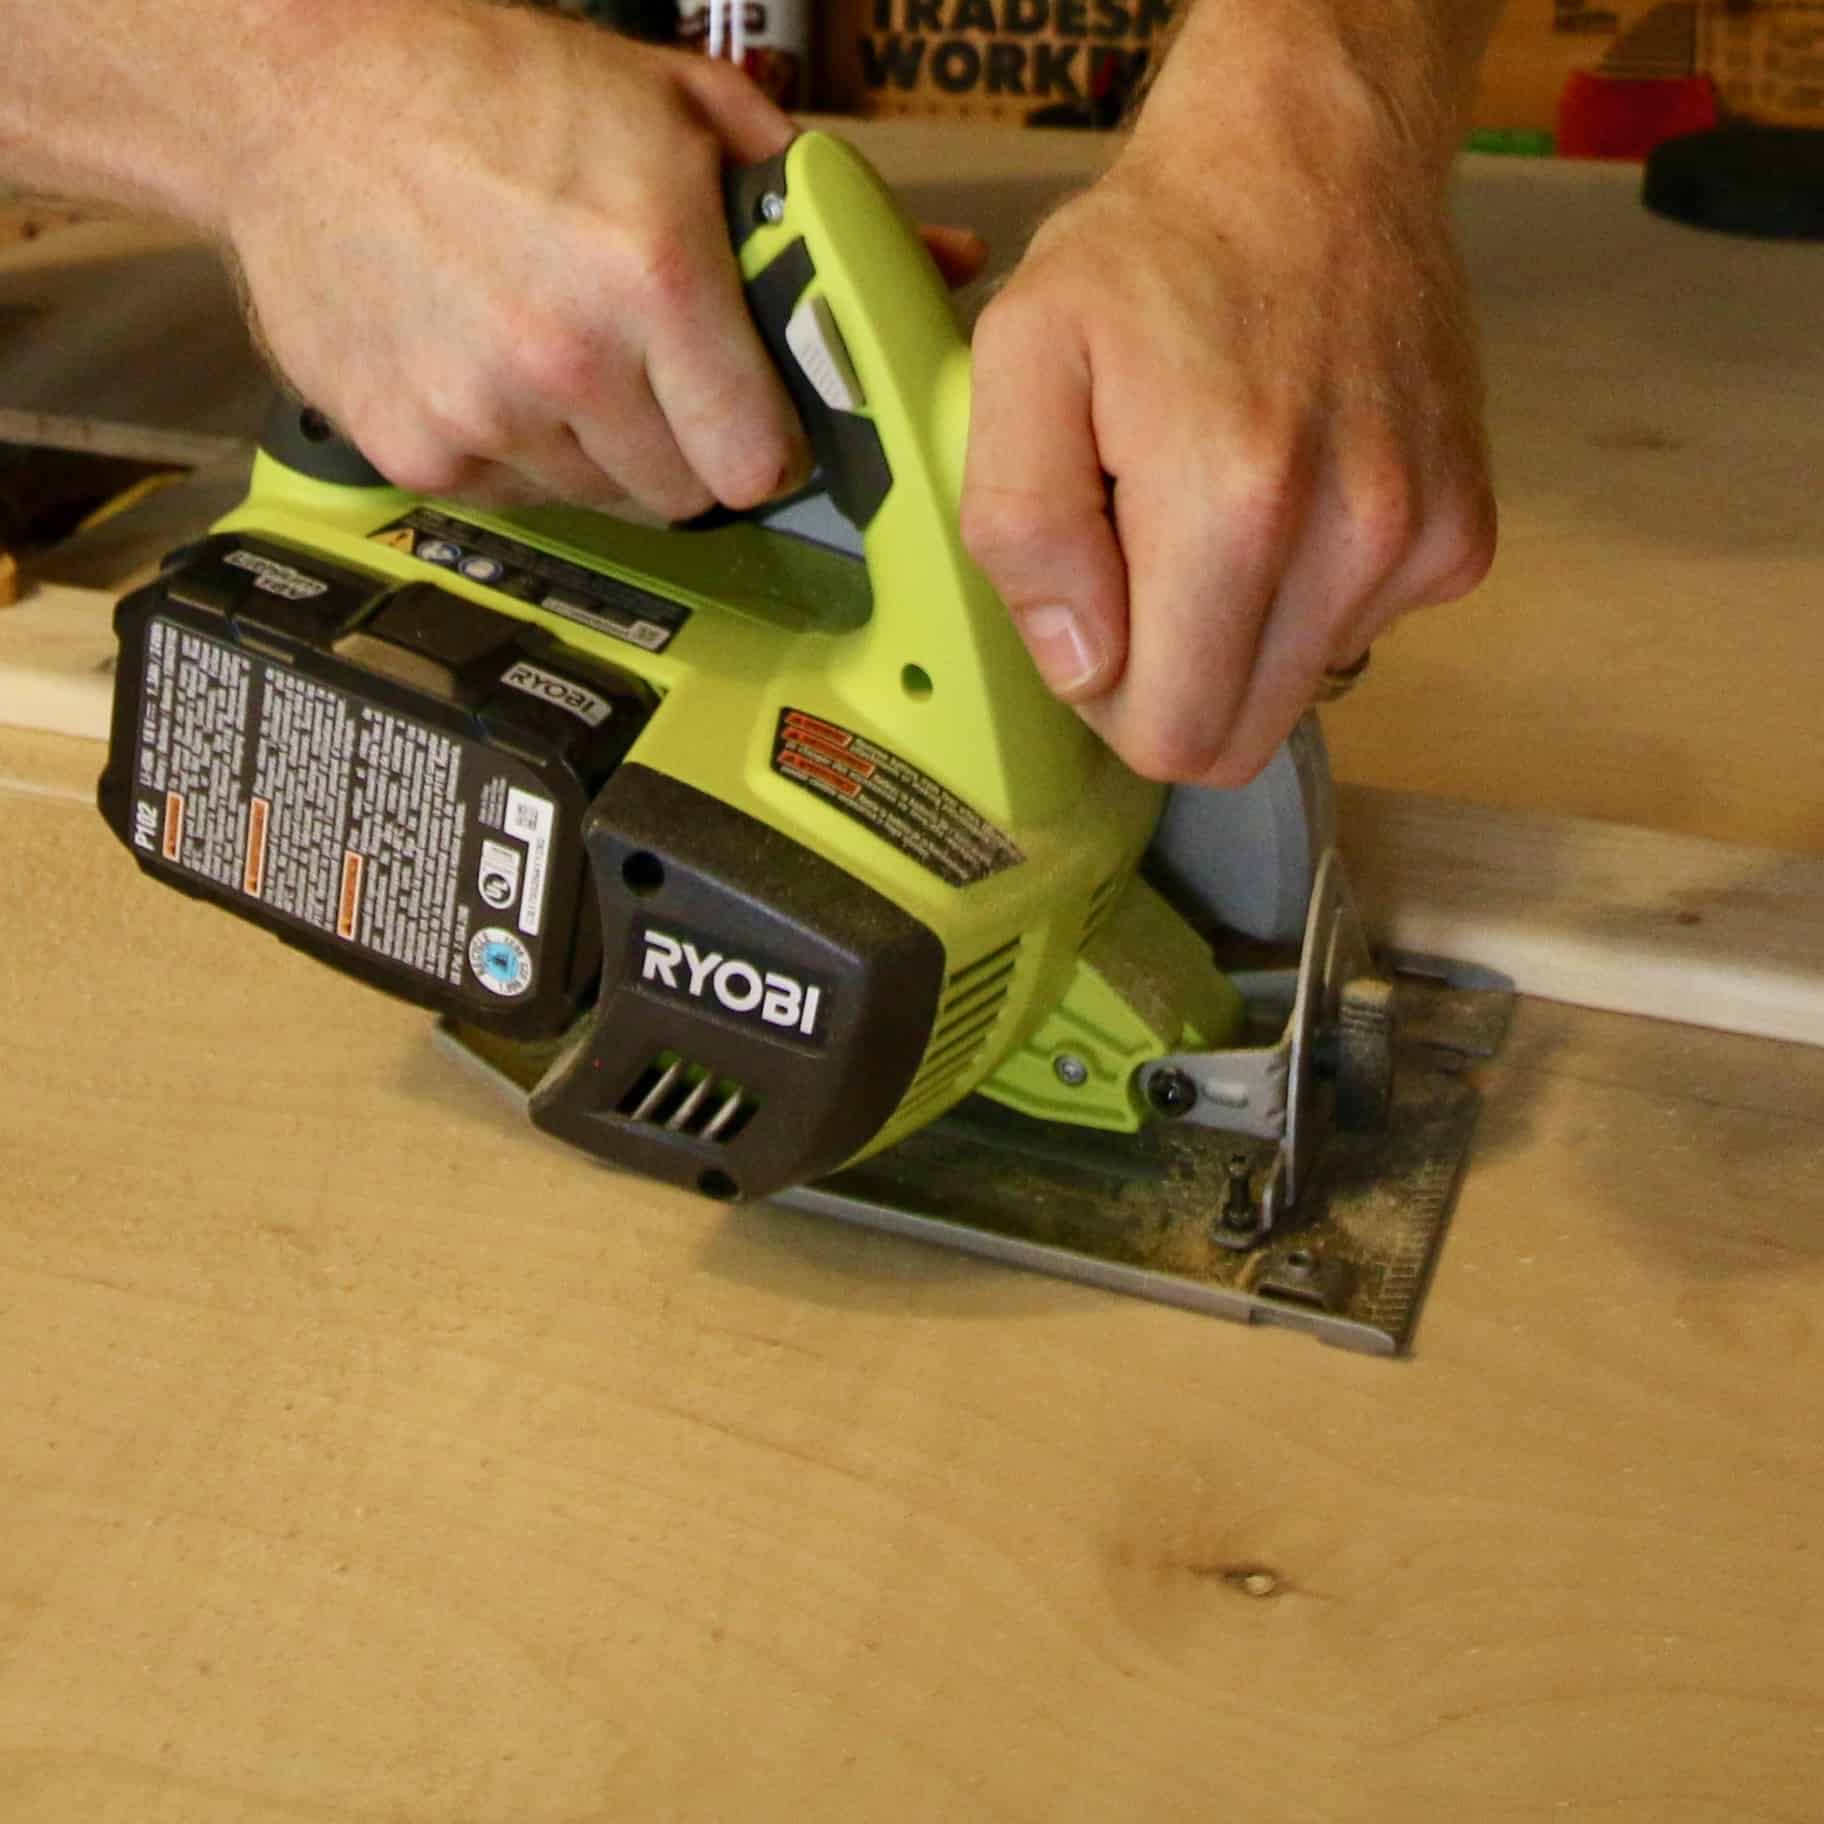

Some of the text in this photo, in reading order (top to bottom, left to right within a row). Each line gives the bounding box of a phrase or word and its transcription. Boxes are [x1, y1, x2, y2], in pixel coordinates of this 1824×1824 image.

[510, 667, 595, 713] RYOBI
[134, 800, 158, 852] P102
[642, 929, 821, 1035] RYOBI
